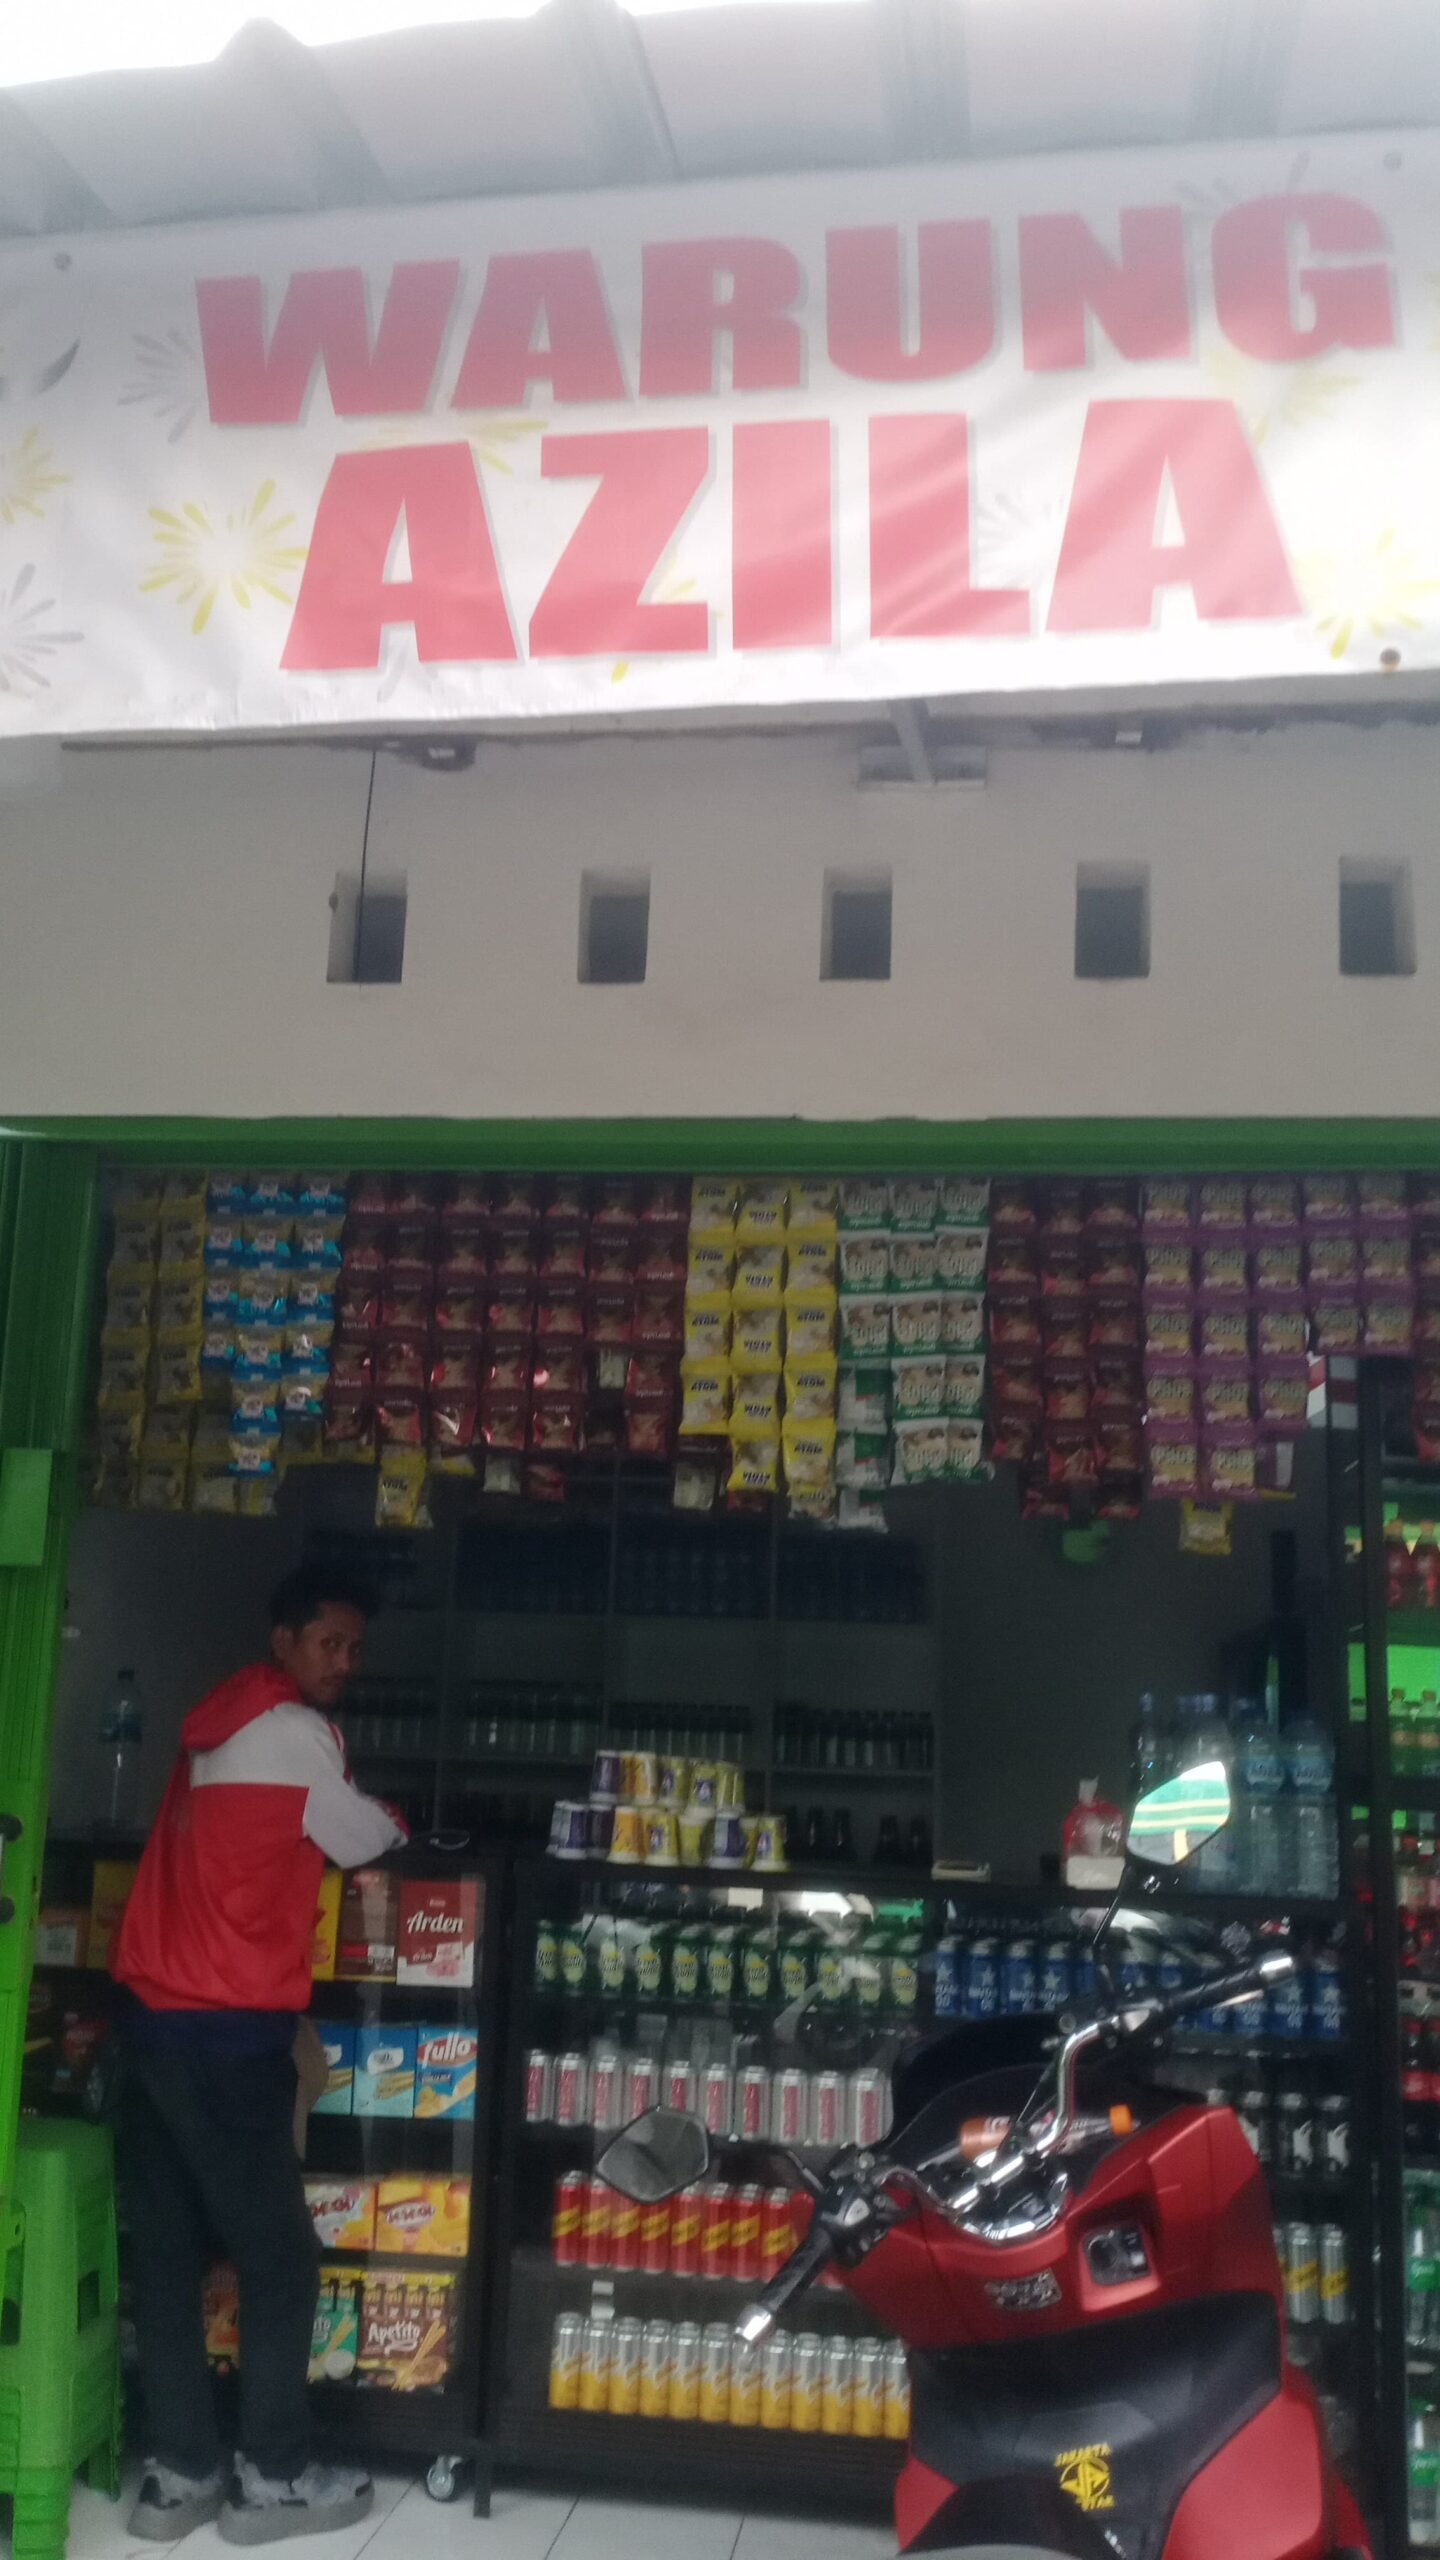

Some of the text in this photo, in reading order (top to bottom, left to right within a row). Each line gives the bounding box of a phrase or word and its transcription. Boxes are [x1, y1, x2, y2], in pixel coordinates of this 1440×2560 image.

[195, 190, 1399, 427] WARUNG
[279, 397, 1304, 670] AZILA
[407, 1909, 464, 1934] Arden
[368, 2320, 421, 2347] Apetito
